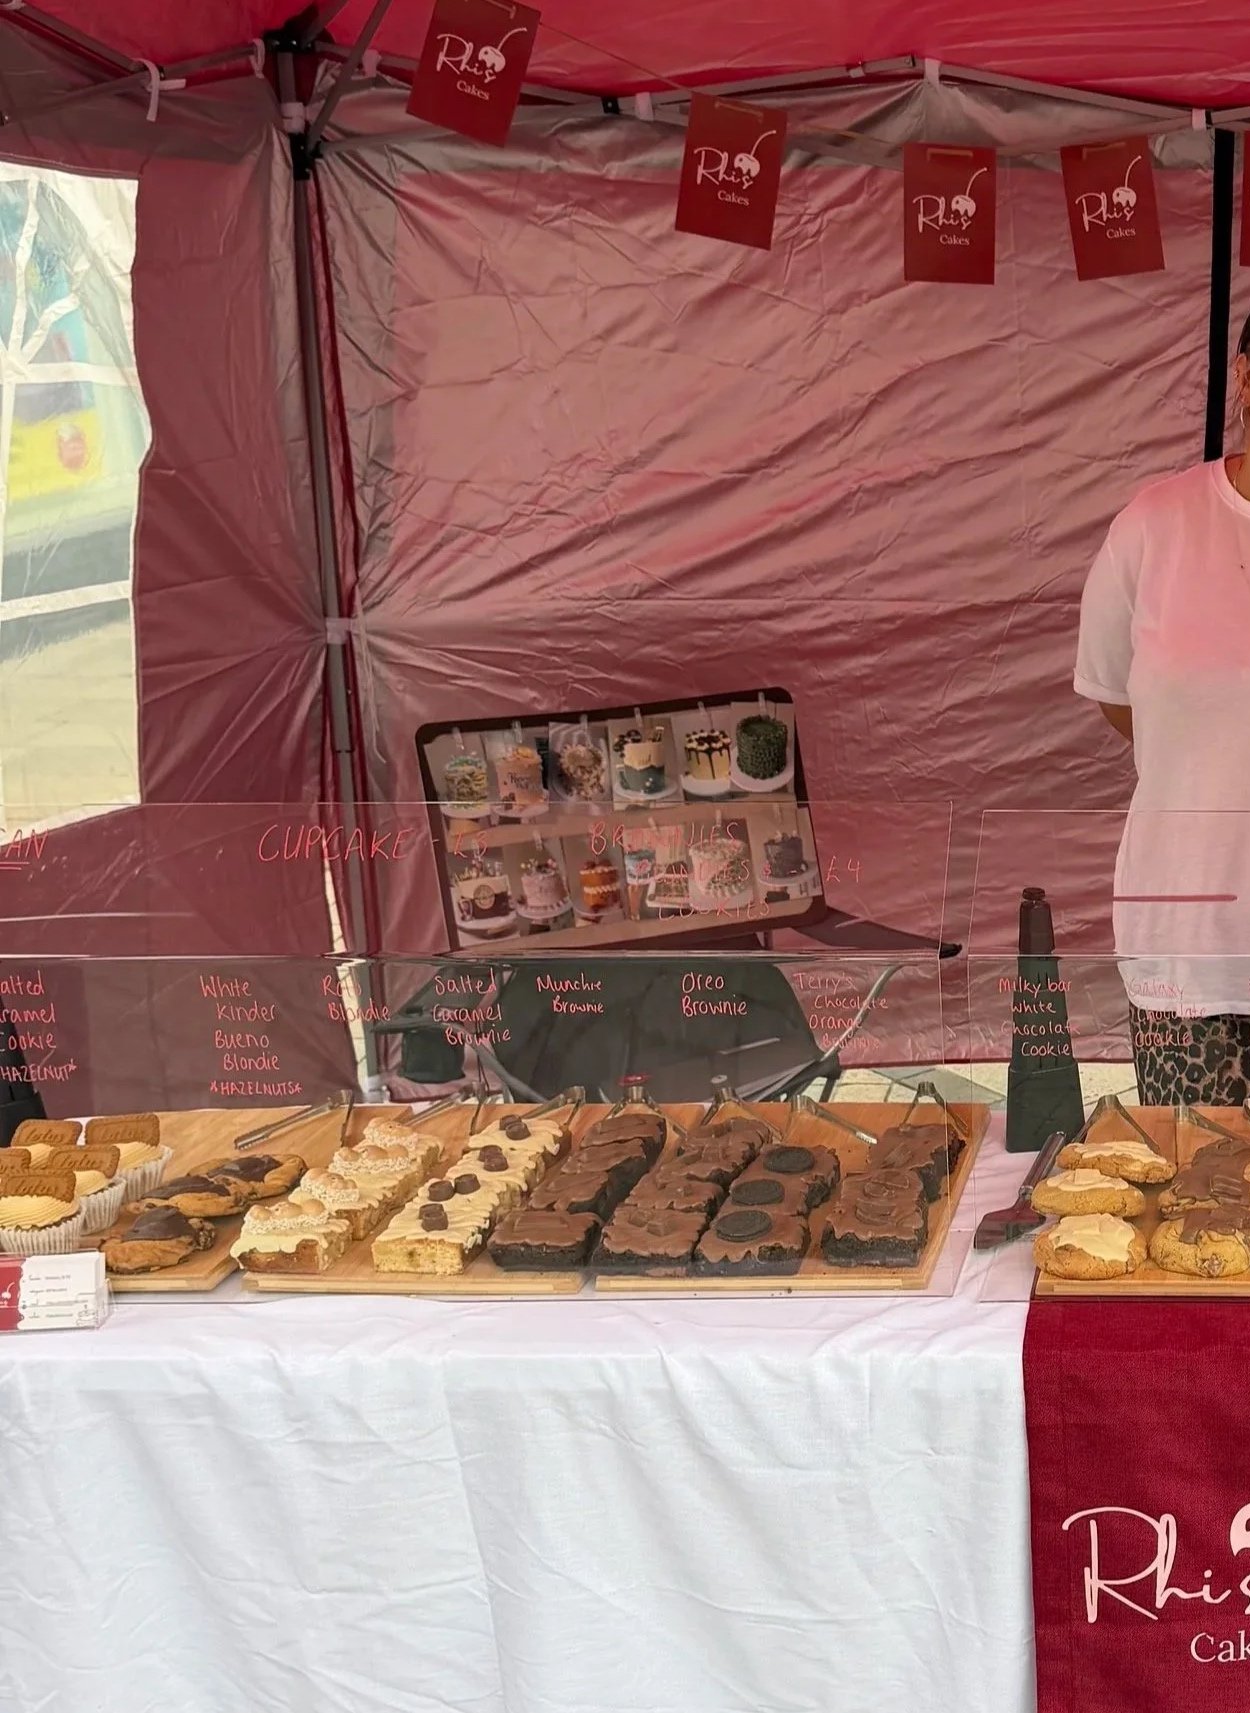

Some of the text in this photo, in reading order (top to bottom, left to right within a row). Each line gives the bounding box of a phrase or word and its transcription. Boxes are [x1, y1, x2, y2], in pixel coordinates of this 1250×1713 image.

[456, 79, 490, 100] Cakes
[717, 189, 750, 207] Cakes
[939, 233, 970, 246] Cakes
[1106, 226, 1136, 240] Cakes
[0, 827, 49, 858] AN
[258, 823, 416, 862] CUPCAKE
[589, 820, 740, 855] BRNIES
[826, 856, 861, 883] £4
[659, 900, 770, 921] COOKIES
[0, 969, 44, 995] alted
[199, 975, 252, 998] White
[435, 967, 497, 996] Salted
[536, 972, 602, 993] Munchie
[681, 971, 725, 994] Oreo
[793, 972, 858, 994] Terry's
[999, 976, 1072, 999] Milky bar
[0, 1002, 55, 1023] ramel
[328, 998, 391, 1022] Blondie
[432, 1003, 503, 1023] Caramel
[552, 995, 605, 1014] Brownie
[681, 994, 749, 1017] Brownie
[814, 995, 889, 1010] Chocolate
[445, 1024, 512, 1046] Brownie
[808, 1014, 864, 1038] Orange
[214, 1030, 270, 1049] Bueno
[1021, 1041, 1072, 1057] Cookie
[223, 1052, 280, 1071] Blondie
